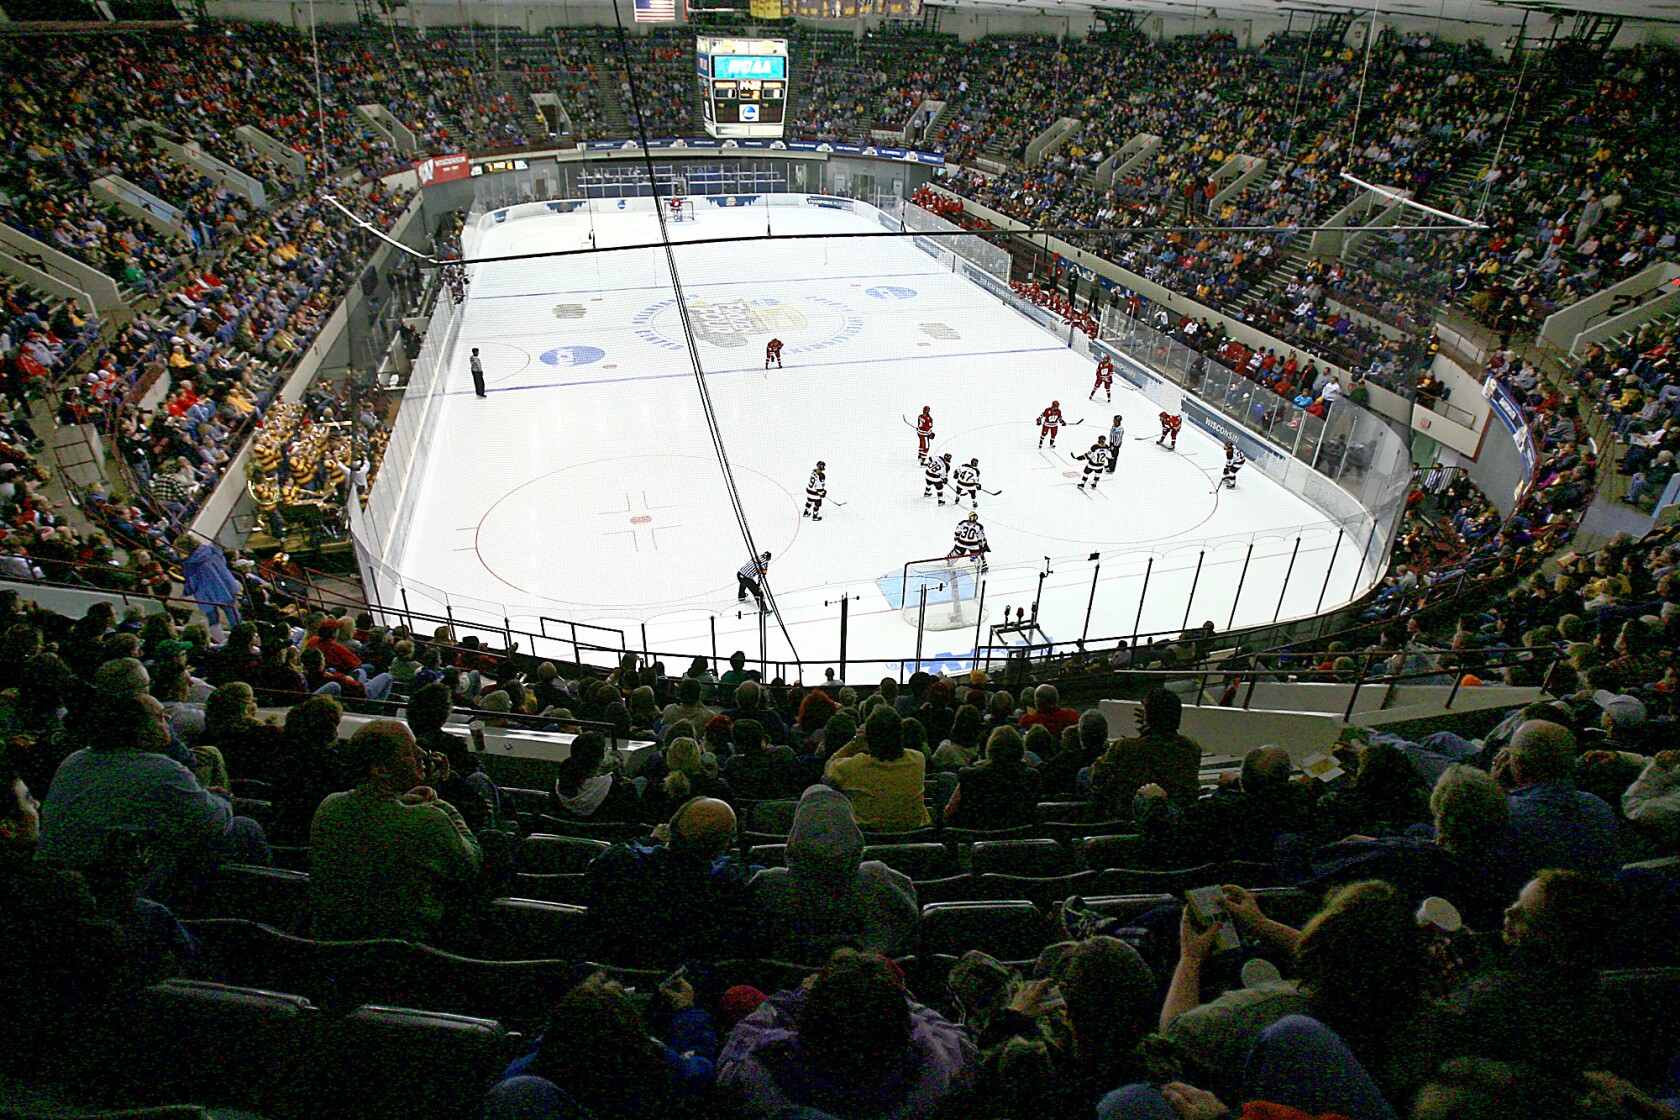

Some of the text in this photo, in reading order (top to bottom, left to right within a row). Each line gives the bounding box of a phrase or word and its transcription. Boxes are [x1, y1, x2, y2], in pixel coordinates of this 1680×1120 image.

[1205, 416, 1240, 443] WISCONSIN
[1097, 452, 1106, 463] 12
[961, 525, 977, 540] 30
